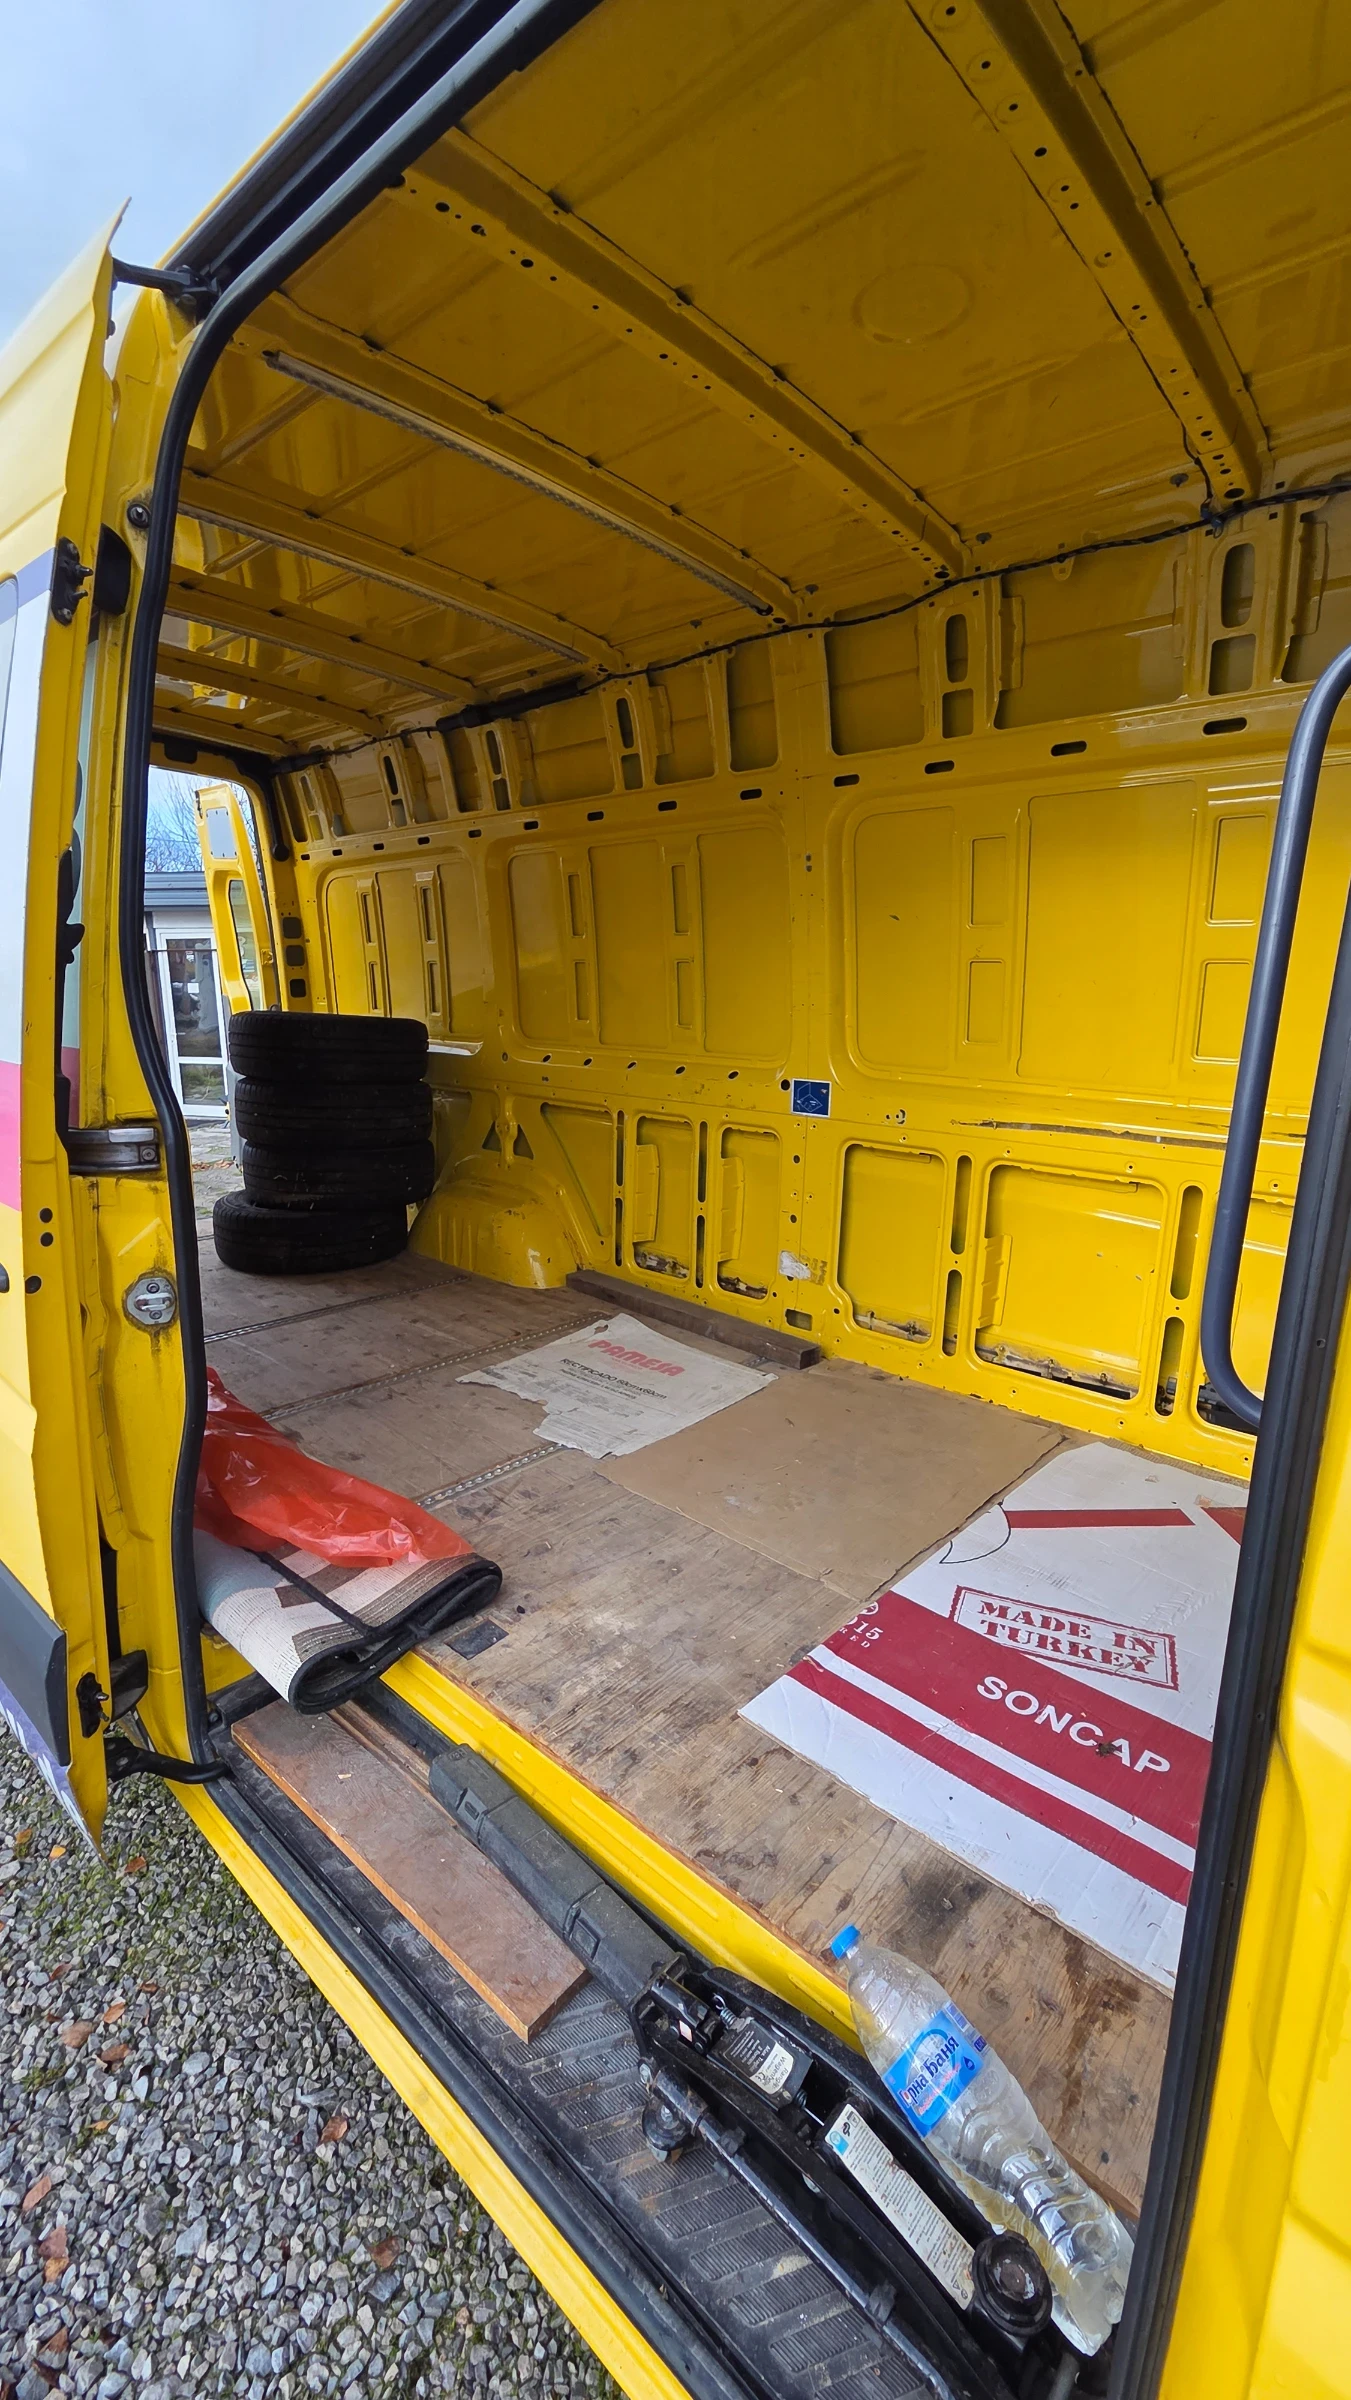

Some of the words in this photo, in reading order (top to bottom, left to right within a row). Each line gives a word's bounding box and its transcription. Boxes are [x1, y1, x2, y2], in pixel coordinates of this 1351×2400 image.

[560, 1358, 618, 1382] RECTIFICADO
[587, 1339, 686, 1377] PAMESA
[978, 1600, 1092, 1640] MADE
[1112, 1632, 1159, 1656] IN
[980, 1619, 1158, 1674] TURKEY
[977, 1676, 1171, 1773] SONCAP
[762, 2056, 787, 2087] Wagenh
[922, 2036, 960, 2078] Баня
